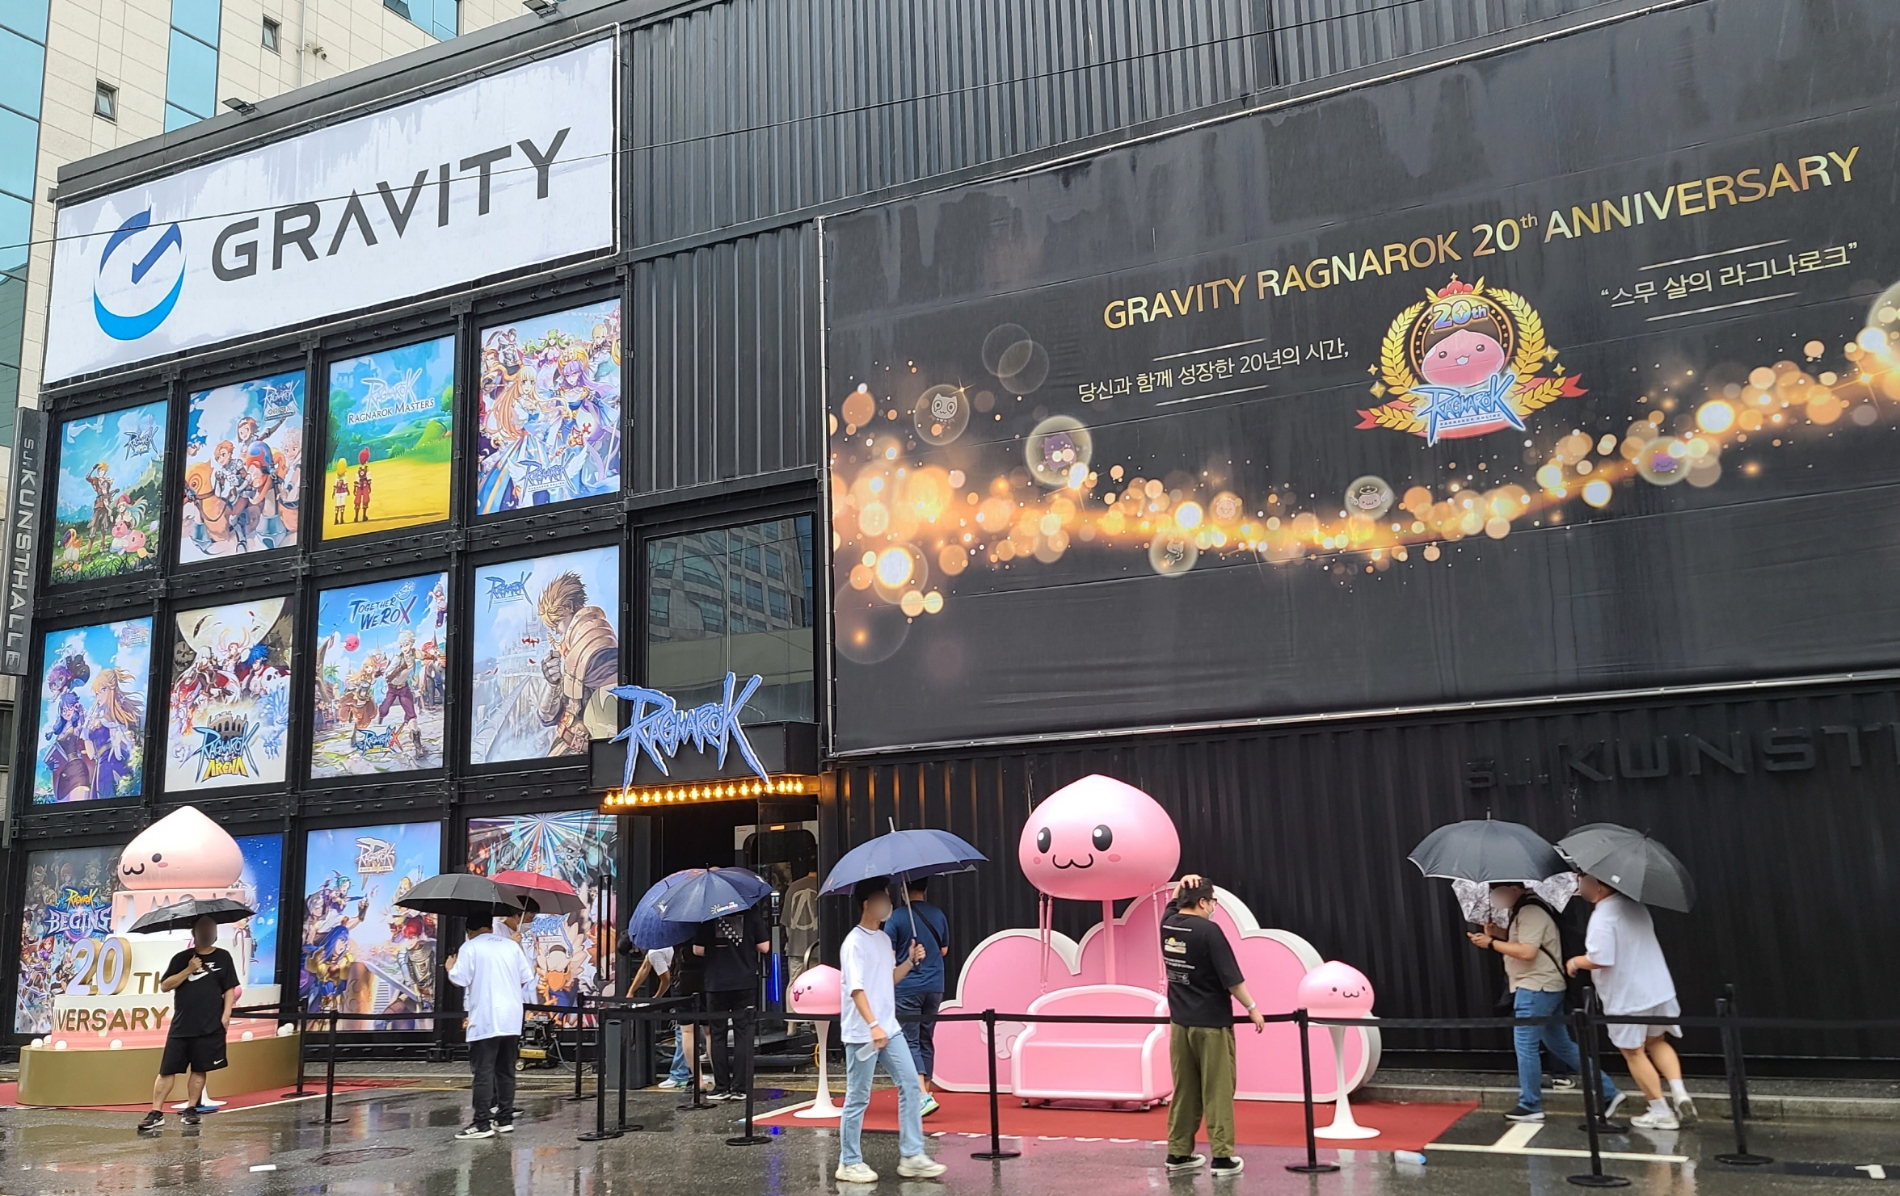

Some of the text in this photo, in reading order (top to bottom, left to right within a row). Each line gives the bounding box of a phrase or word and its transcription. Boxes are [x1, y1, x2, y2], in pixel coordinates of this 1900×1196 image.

[211, 127, 572, 281] GRAVITY
[1103, 146, 1860, 329] GRAVITY RAGNAROK 20th ANNIVERSARY
[1663, 270, 1713, 300] 살의
[1432, 300, 1488, 330] 20th
[1079, 337, 1350, 403] 당신과 함께 성장한 20년의 시간,
[348, 398, 434, 424] RAGNAROK MASTERS
[349, 596, 397, 622] TOGETHER
[200, 755, 250, 783] ARENA
[44, 904, 113, 935] BEGINS
[65, 936, 132, 996] 20
